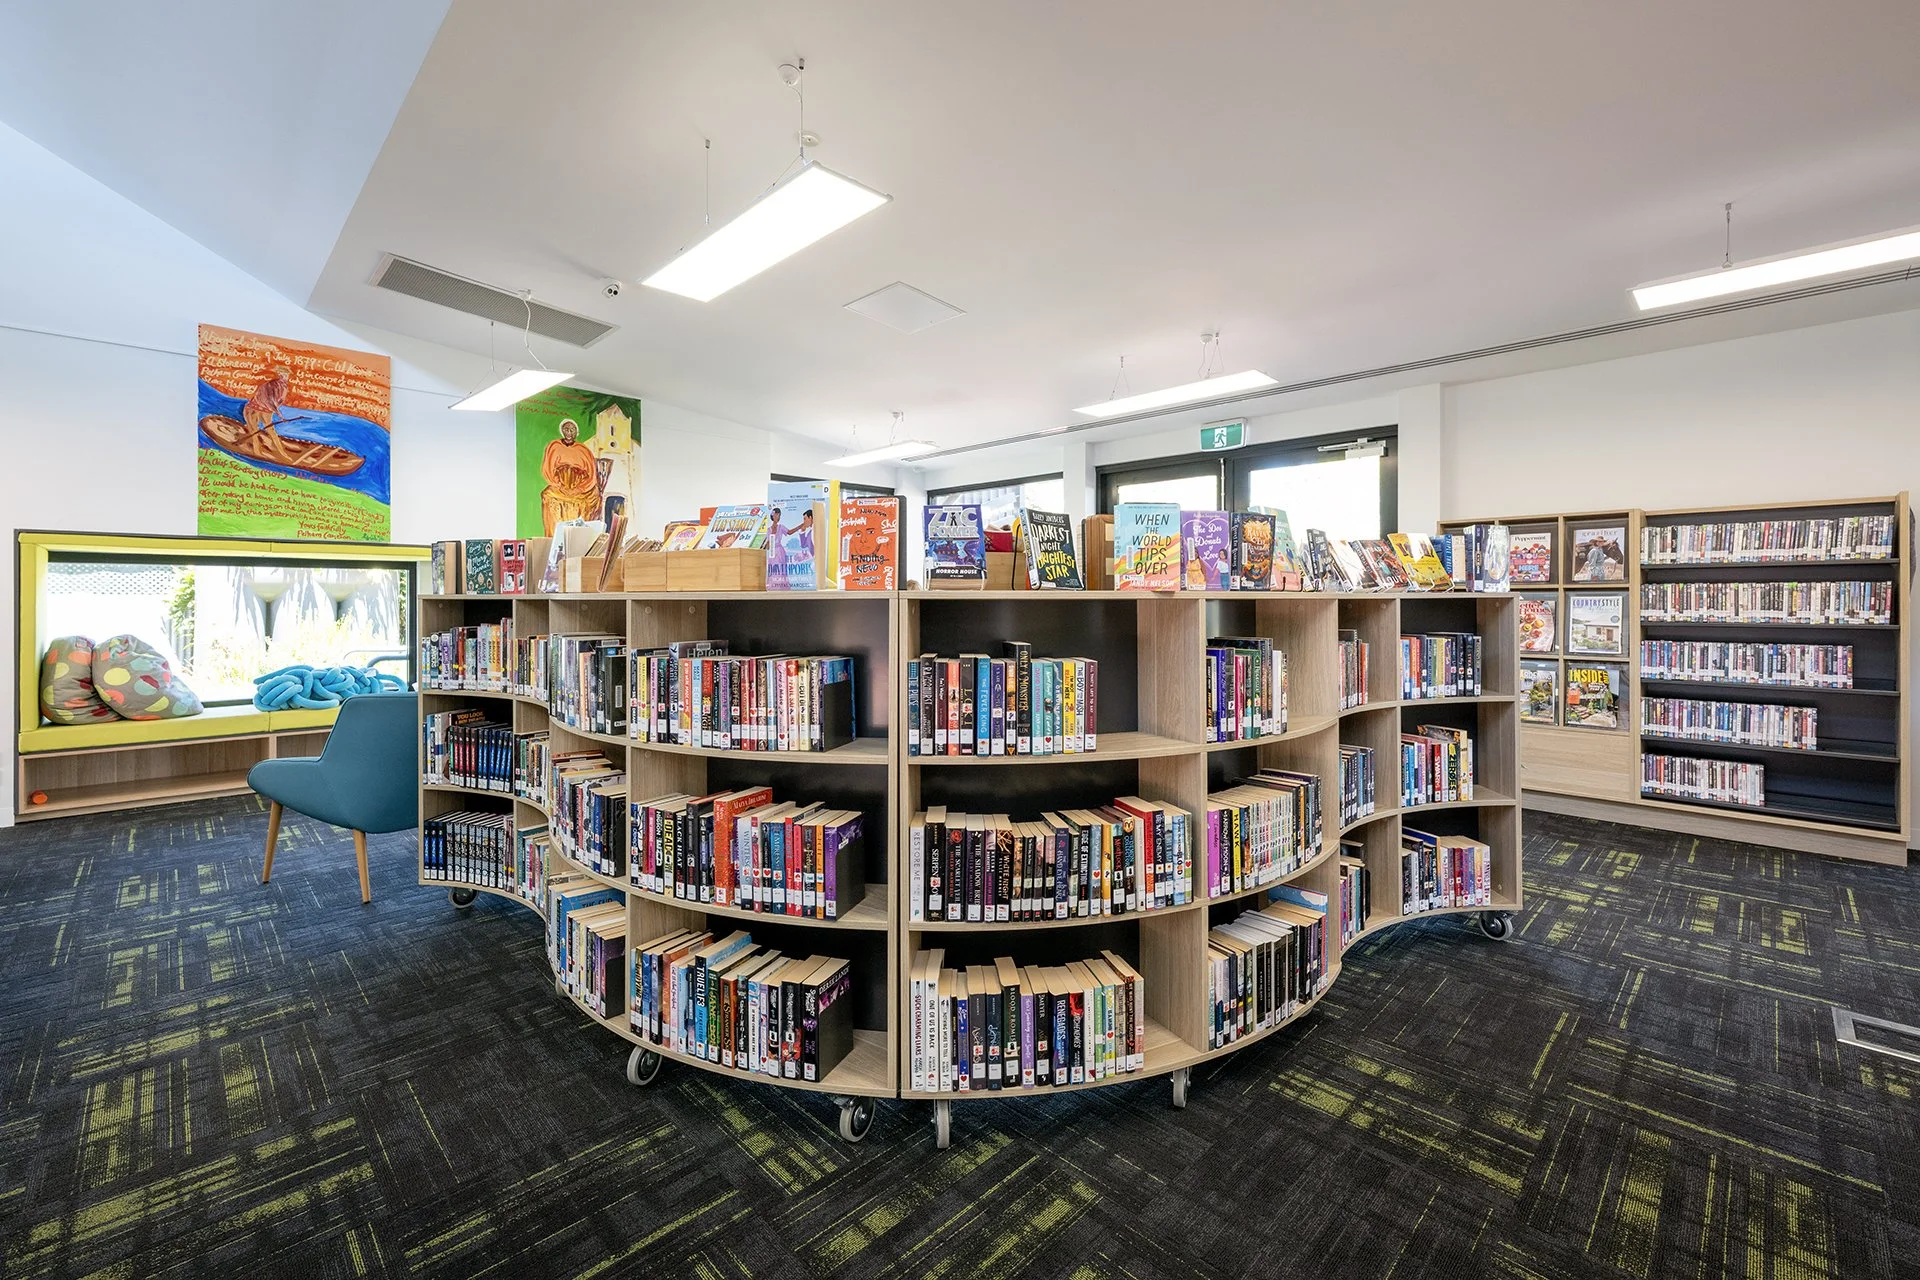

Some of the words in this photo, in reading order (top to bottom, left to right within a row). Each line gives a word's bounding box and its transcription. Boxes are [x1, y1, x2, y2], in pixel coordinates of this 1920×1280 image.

[929, 506, 979, 528] ZAC
[1134, 513, 1171, 526] WHEN
[929, 525, 980, 539] POWER
[1031, 521, 1070, 545] DARKEST
[1145, 526, 1160, 535] THE
[1193, 524, 1206, 534] The
[1040, 540, 1062, 551] NIGHT
[1132, 535, 1172, 546] WORLD
[1036, 551, 1076, 569] BRIGHTEST
[1137, 547, 1167, 561] TIPS
[1202, 551, 1219, 560] Love
[1045, 564, 1071, 581] STAR
[1135, 562, 1169, 576] OVER
[1129, 579, 1149, 587] JANDY
[1149, 578, 1175, 587] NELSON
[687, 647, 724, 660] Helen
[1019, 650, 1028, 671] ONLY
[908, 676, 919, 687] THE
[1569, 668, 1603, 683] INSIDE
[1076, 677, 1084, 692] BOY
[980, 689, 989, 713] FEVER
[1018, 677, 1029, 711] MONSTER
[980, 714, 989, 734] KING
[1155, 814, 1162, 824] BE
[1081, 829, 1089, 844] EDGE
[1155, 824, 1163, 836] MY
[913, 831, 921, 870] RESTORE
[974, 843, 982, 859] THE
[1081, 845, 1089, 853] OF
[1155, 837, 1163, 863] ENEMY
[1056, 850, 1064, 868] HAND
[913, 870, 921, 881] ME
[974, 858, 982, 888] SHADOW
[1080, 853, 1089, 886] EXTINCTION
[1002, 878, 1010, 900] NIGHT
[914, 994, 922, 1010] SUCH
[928, 999, 936, 1010] ONE
[914, 1010, 922, 1039] CHARMING
[928, 1019, 936, 1027] US
[1056, 999, 1066, 1041] RENEGADES
[914, 1040, 922, 1056] LIARS
[928, 1034, 936, 1049] BACK
